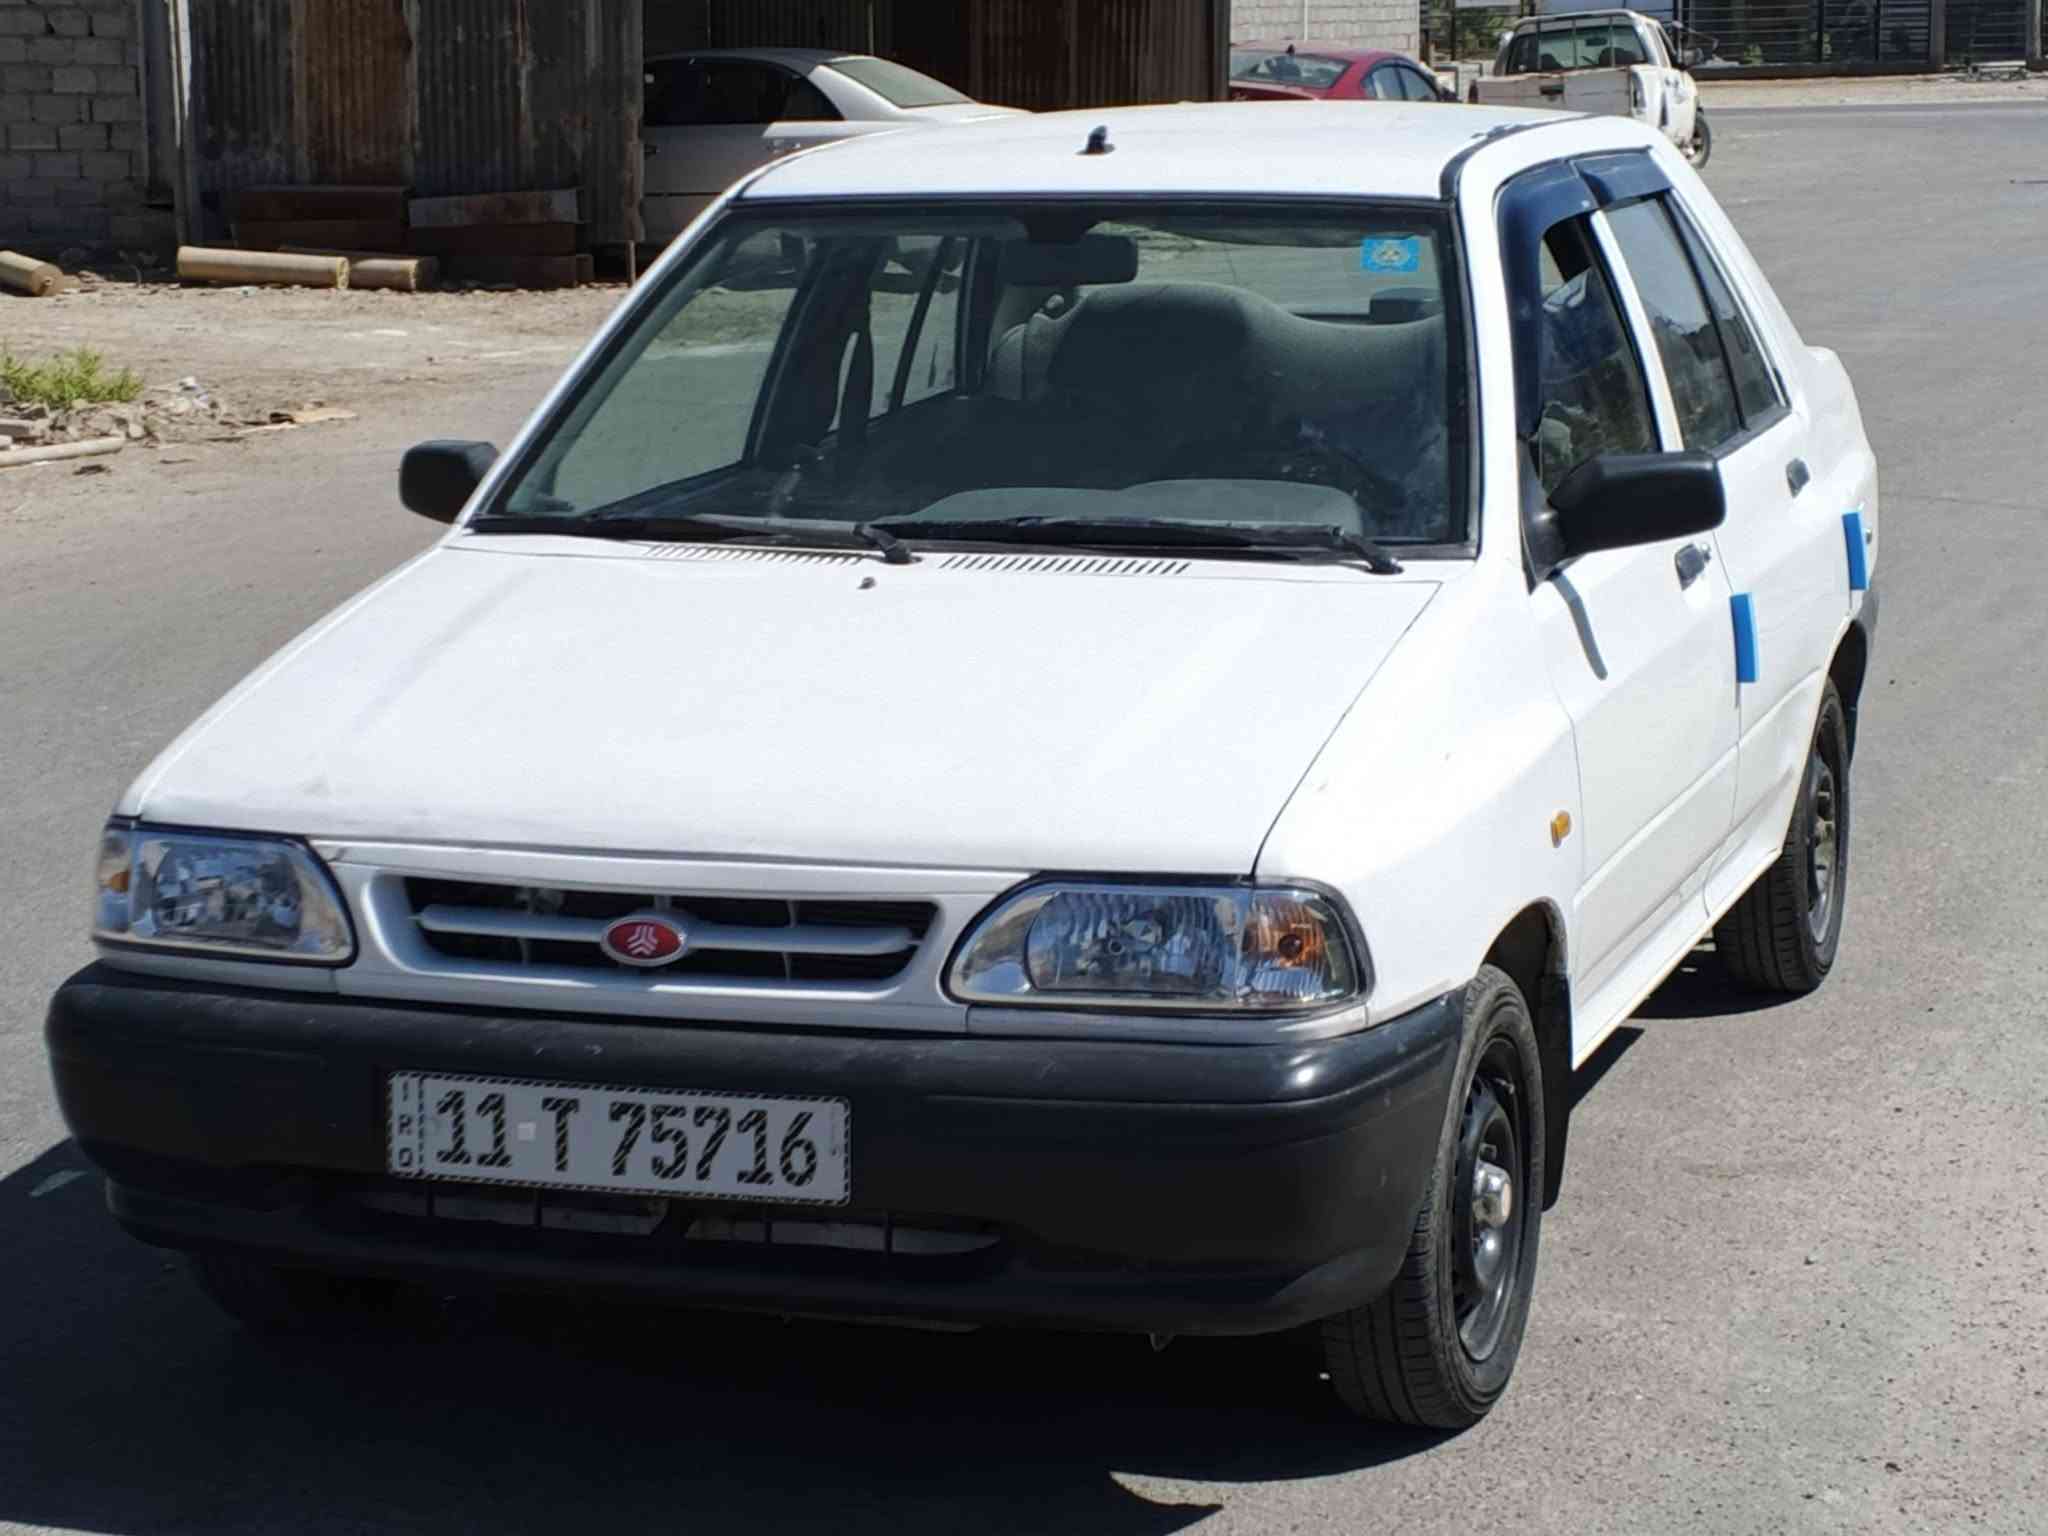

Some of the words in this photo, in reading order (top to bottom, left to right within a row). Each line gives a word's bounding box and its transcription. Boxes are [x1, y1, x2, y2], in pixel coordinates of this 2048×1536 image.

[436, 1089, 512, 1168] 11
[542, 1096, 580, 1171] T
[609, 1101, 818, 1187] 75716
